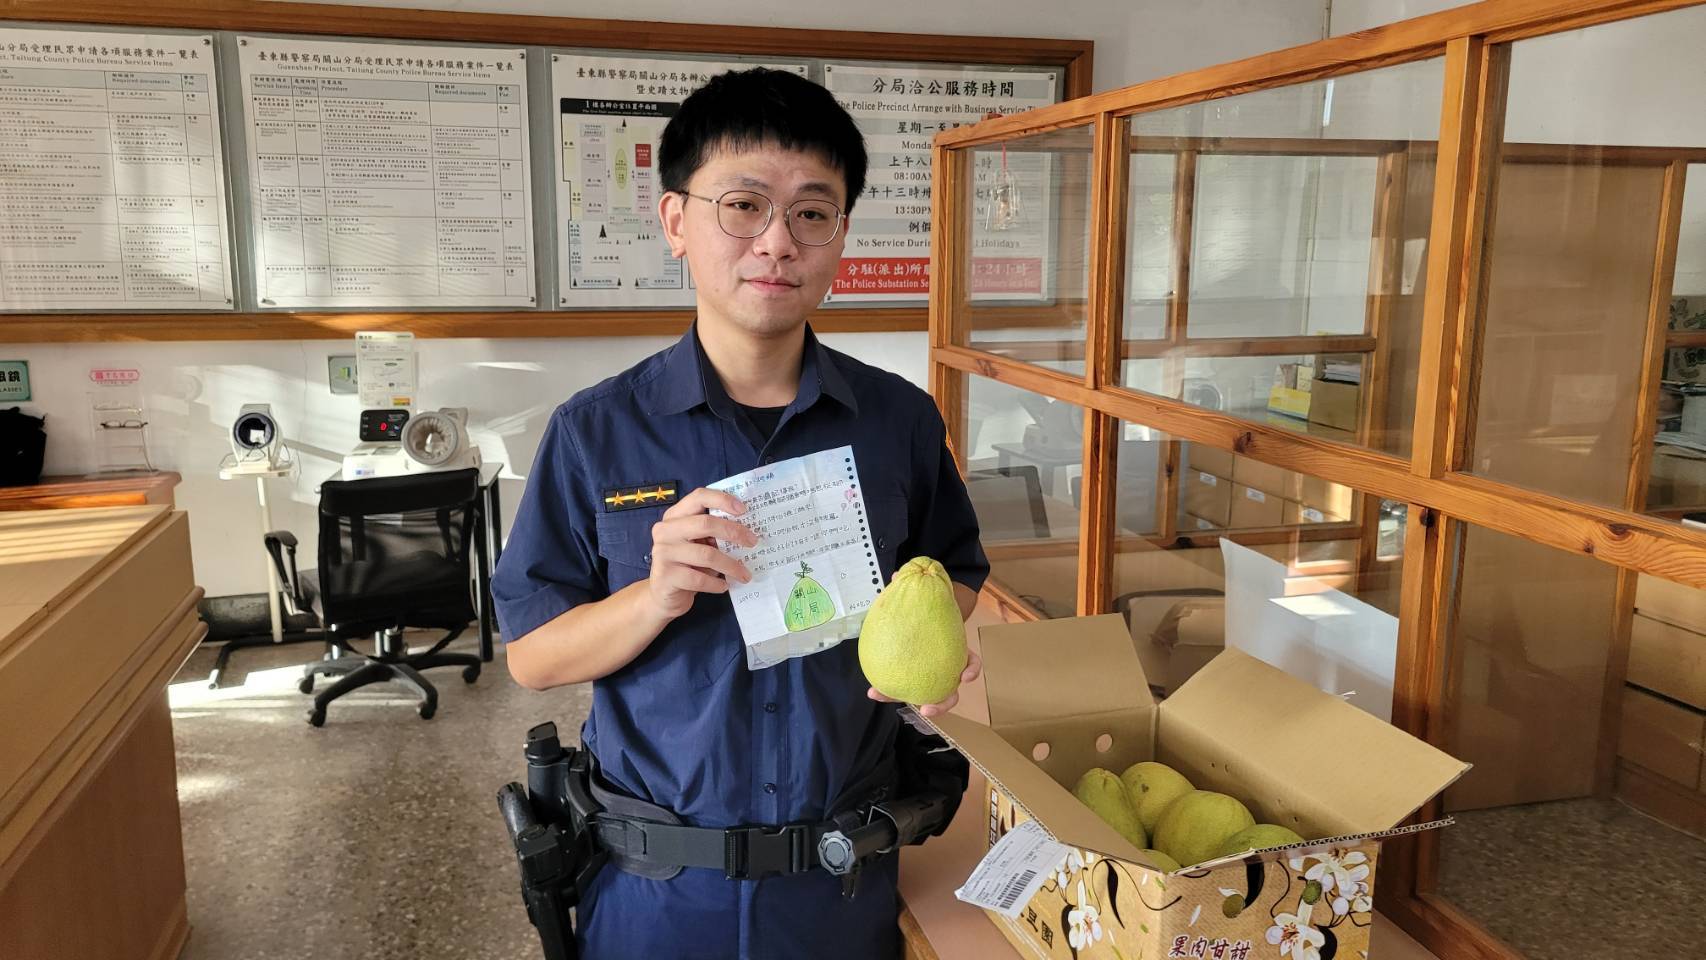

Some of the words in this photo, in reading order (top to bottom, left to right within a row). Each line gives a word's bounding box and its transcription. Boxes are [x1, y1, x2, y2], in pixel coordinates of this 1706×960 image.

[43, 55, 70, 65] County
[376, 68, 399, 76] County
[576, 67, 712, 83] 臺東縣警察局關山分局各辦公
[872, 77, 1014, 97] 分局洽公服務時間
[852, 101, 875, 110] Police
[877, 102, 909, 112] Precinct
[911, 103, 943, 114] Arrange
[945, 104, 961, 113] with
[964, 104, 997, 114] Business
[999, 105, 1026, 114] Service
[902, 140, 931, 149] Monda
[888, 155, 932, 168] 上午八
[909, 221, 931, 233] 例假
[857, 239, 869, 247] No
[871, 239, 905, 247] Service
[835, 279, 850, 288] The
[852, 279, 876, 288] Police
[877, 280, 918, 288] Substation
[1169, 935, 1251, 960] 果肉甘甜
